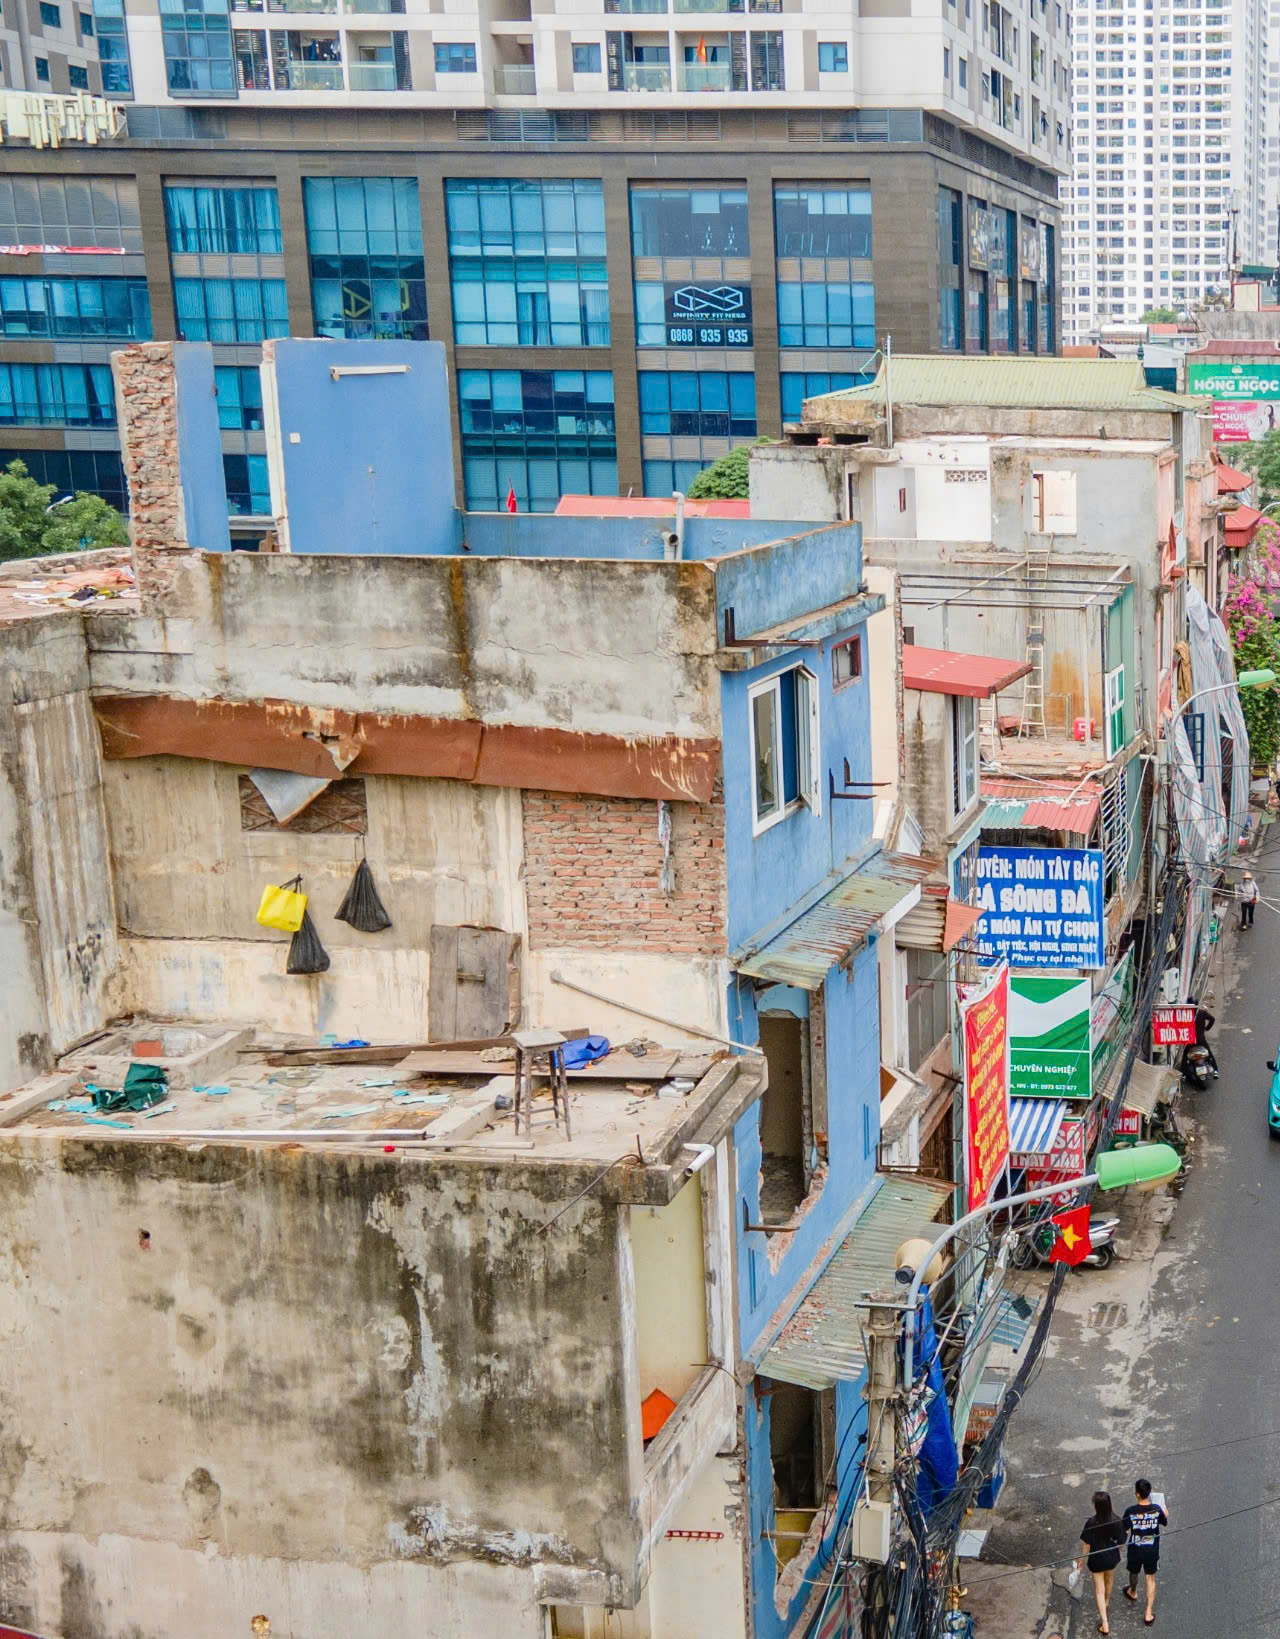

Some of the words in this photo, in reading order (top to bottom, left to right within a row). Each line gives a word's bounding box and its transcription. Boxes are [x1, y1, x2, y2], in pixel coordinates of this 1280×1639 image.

[670, 328, 694, 343] 0868
[700, 328, 721, 343] 935
[728, 328, 749, 343] 935
[1238, 379, 1280, 394] NGỌC
[1015, 855, 1045, 880] MÓN
[1048, 855, 1071, 881] TÂY
[1073, 853, 1100, 881] BẮC
[1000, 883, 1057, 913] SÔNG
[1061, 885, 1092, 914] ĐÀ
[990, 916, 1021, 936] MÓN
[1024, 917, 1043, 936] ĂN
[1045, 919, 1063, 940] TỰ
[1063, 921, 1100, 940] CHỌN
[1178, 1028, 1190, 1042] XE
